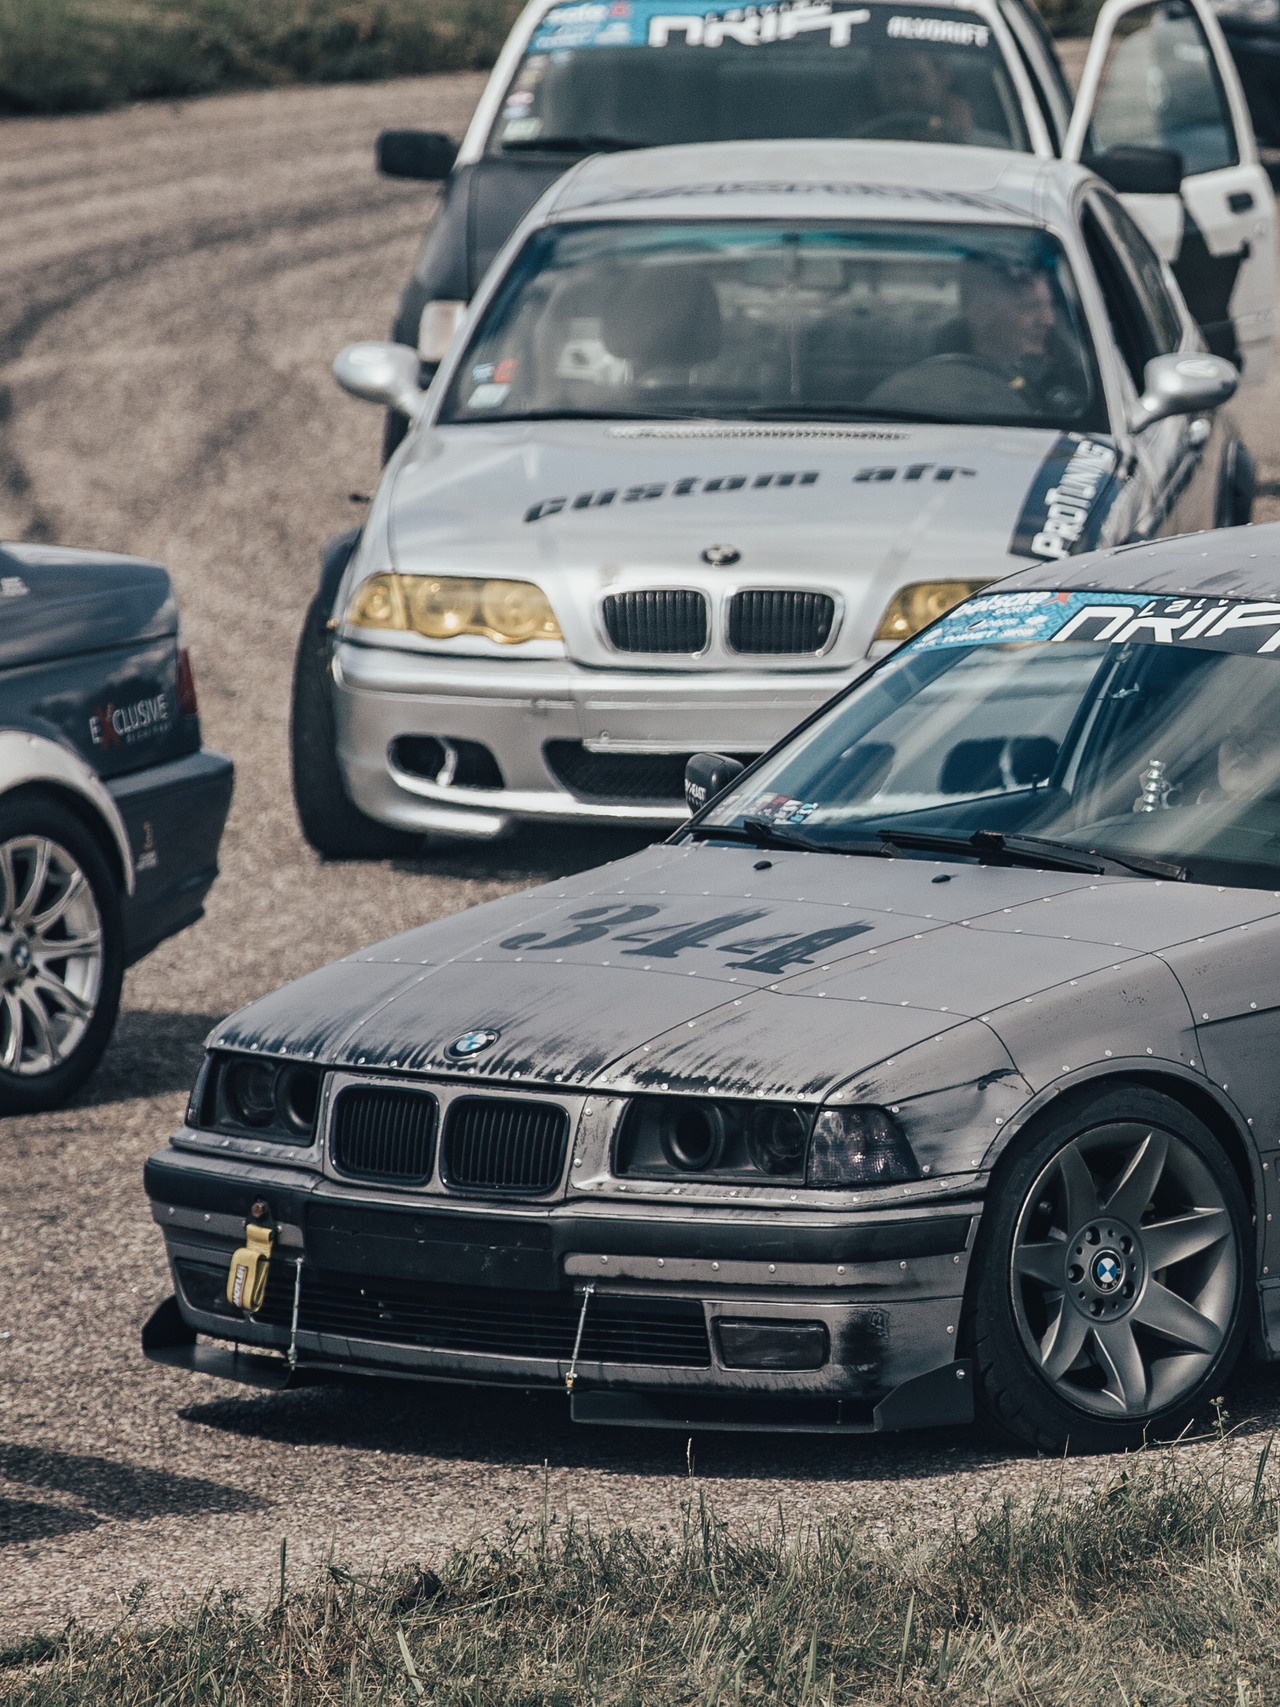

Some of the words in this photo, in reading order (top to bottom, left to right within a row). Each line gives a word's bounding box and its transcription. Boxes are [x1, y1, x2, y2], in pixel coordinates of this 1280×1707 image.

[648, 9, 870, 48] DRIFT
[88, 693, 168, 750] EXCLUSIVE
[500, 904, 880, 974] 344
